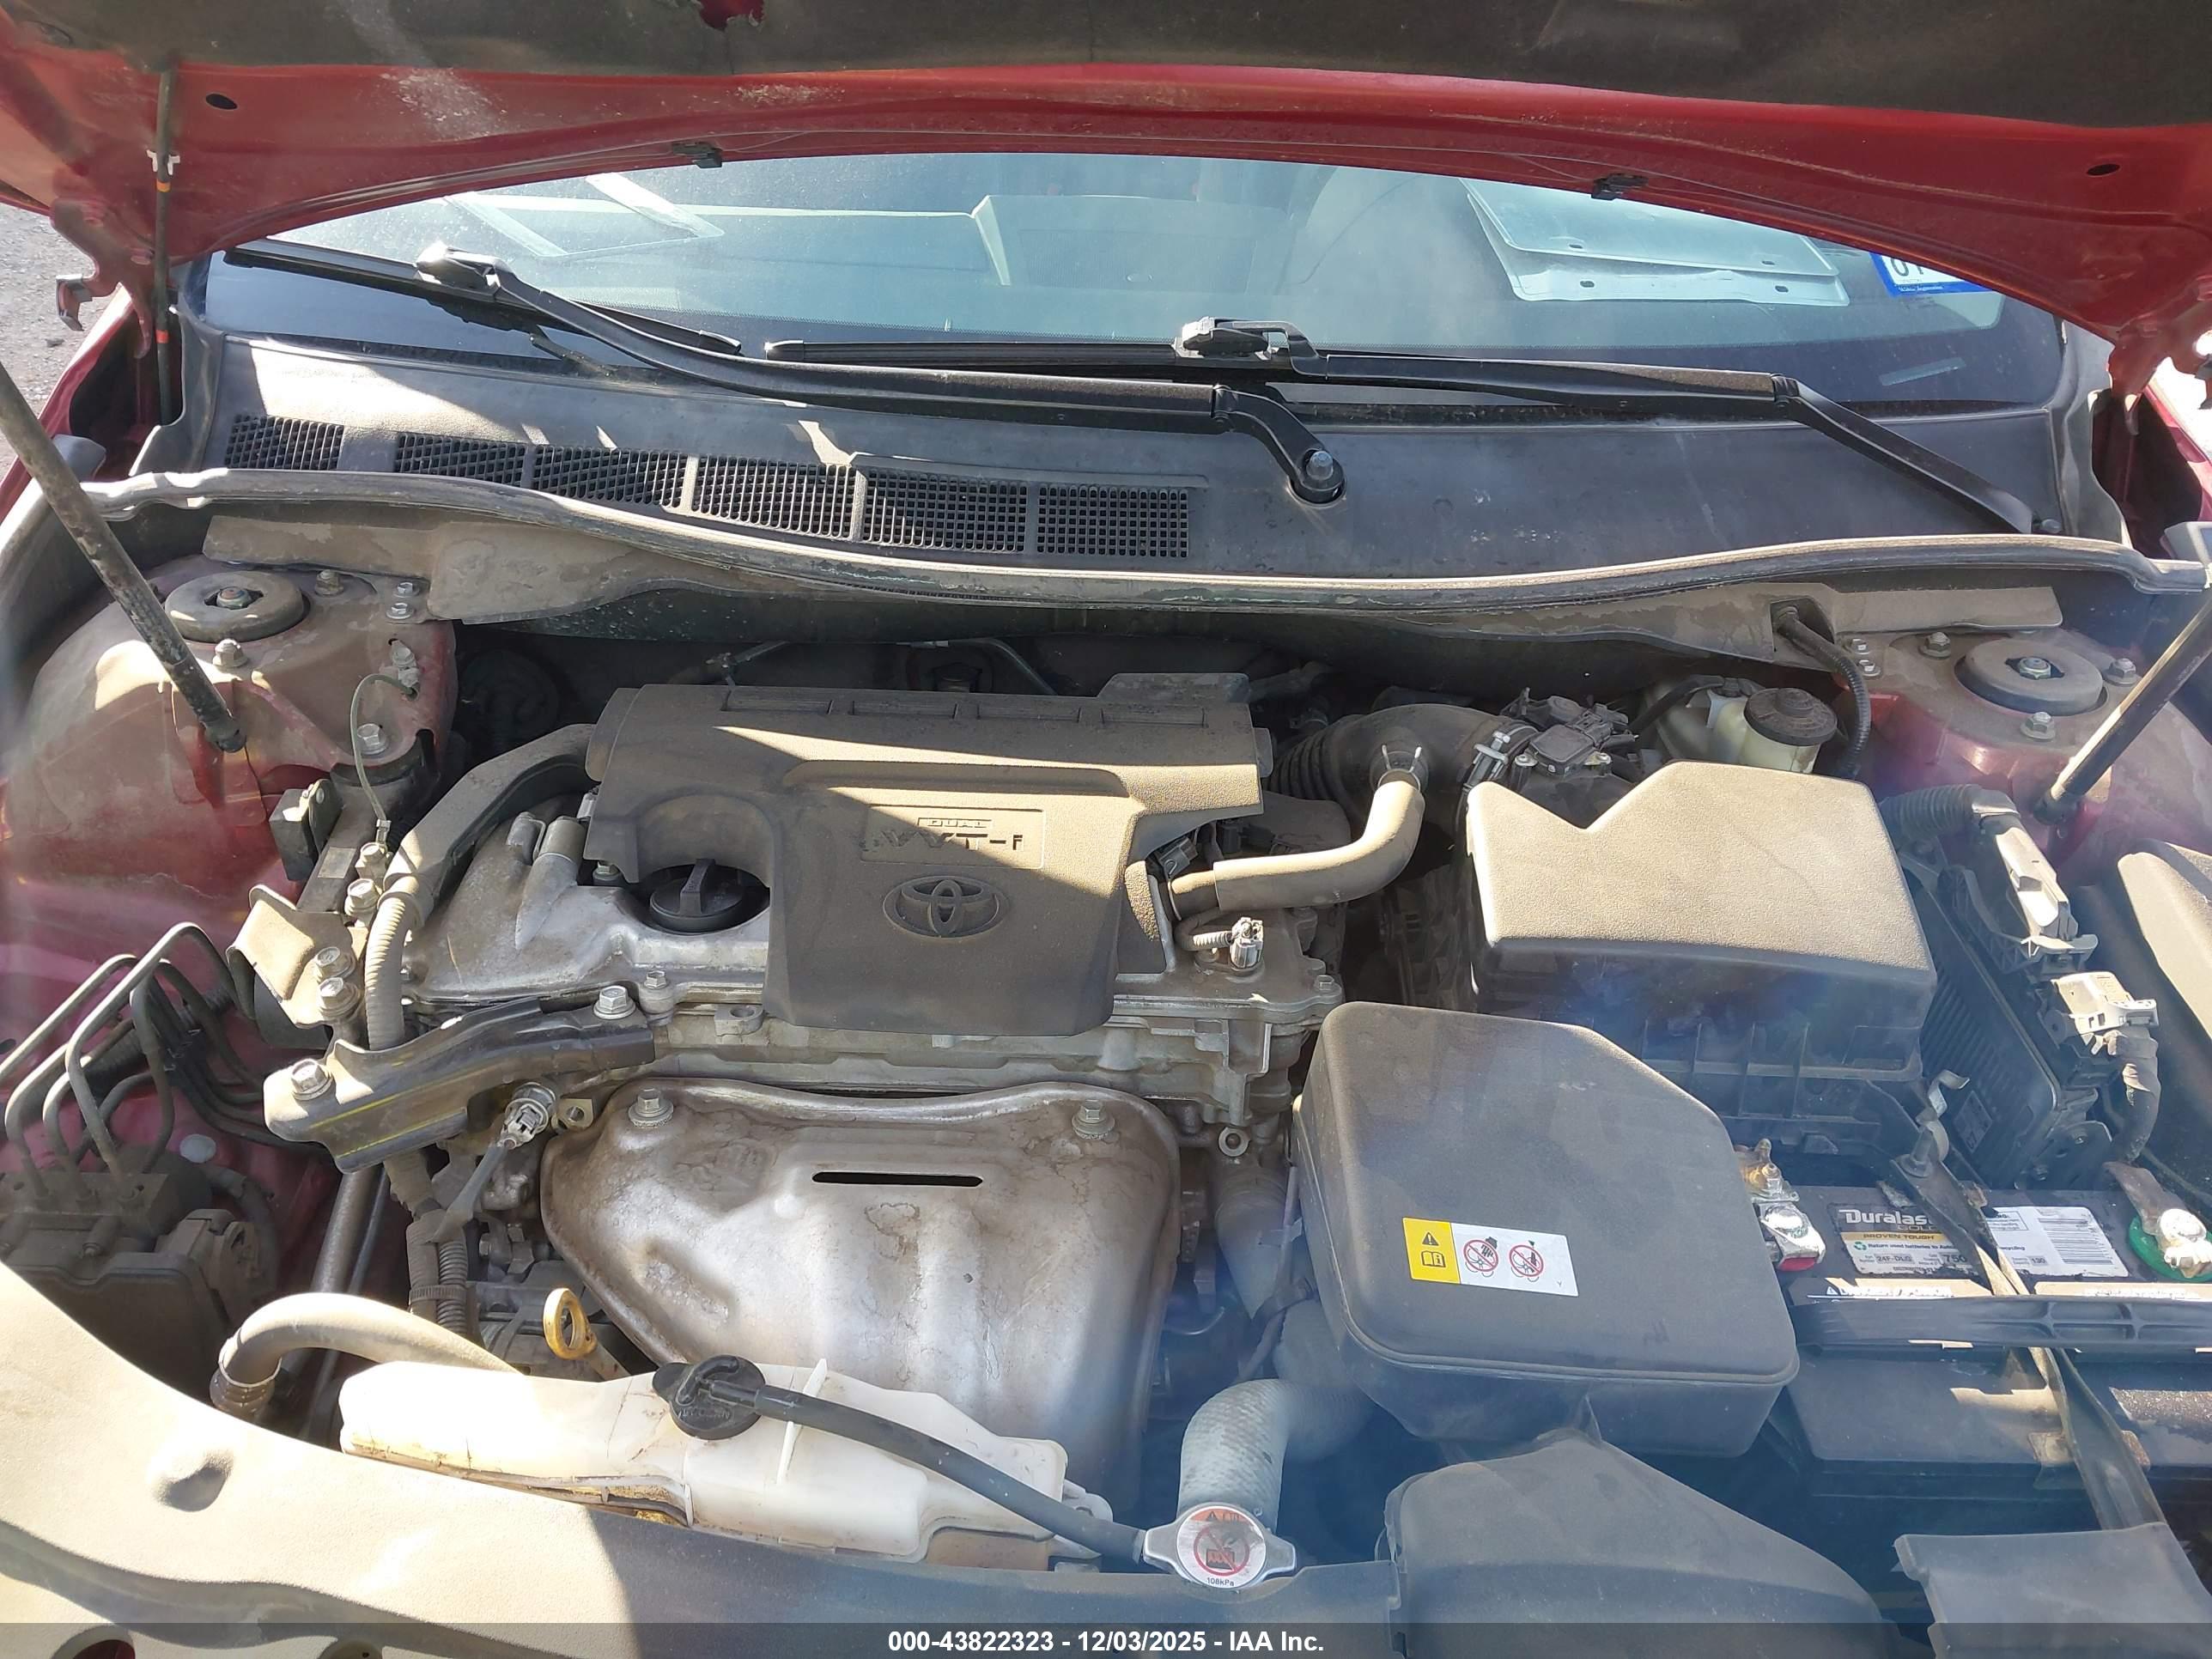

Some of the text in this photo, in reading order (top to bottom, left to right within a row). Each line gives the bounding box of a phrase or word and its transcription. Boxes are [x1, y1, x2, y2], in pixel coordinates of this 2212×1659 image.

[1838, 1209, 1935, 1225] Duralas
[1943, 1255, 1967, 1263] 750
[1206, 1577, 1235, 1587] 108kPa
